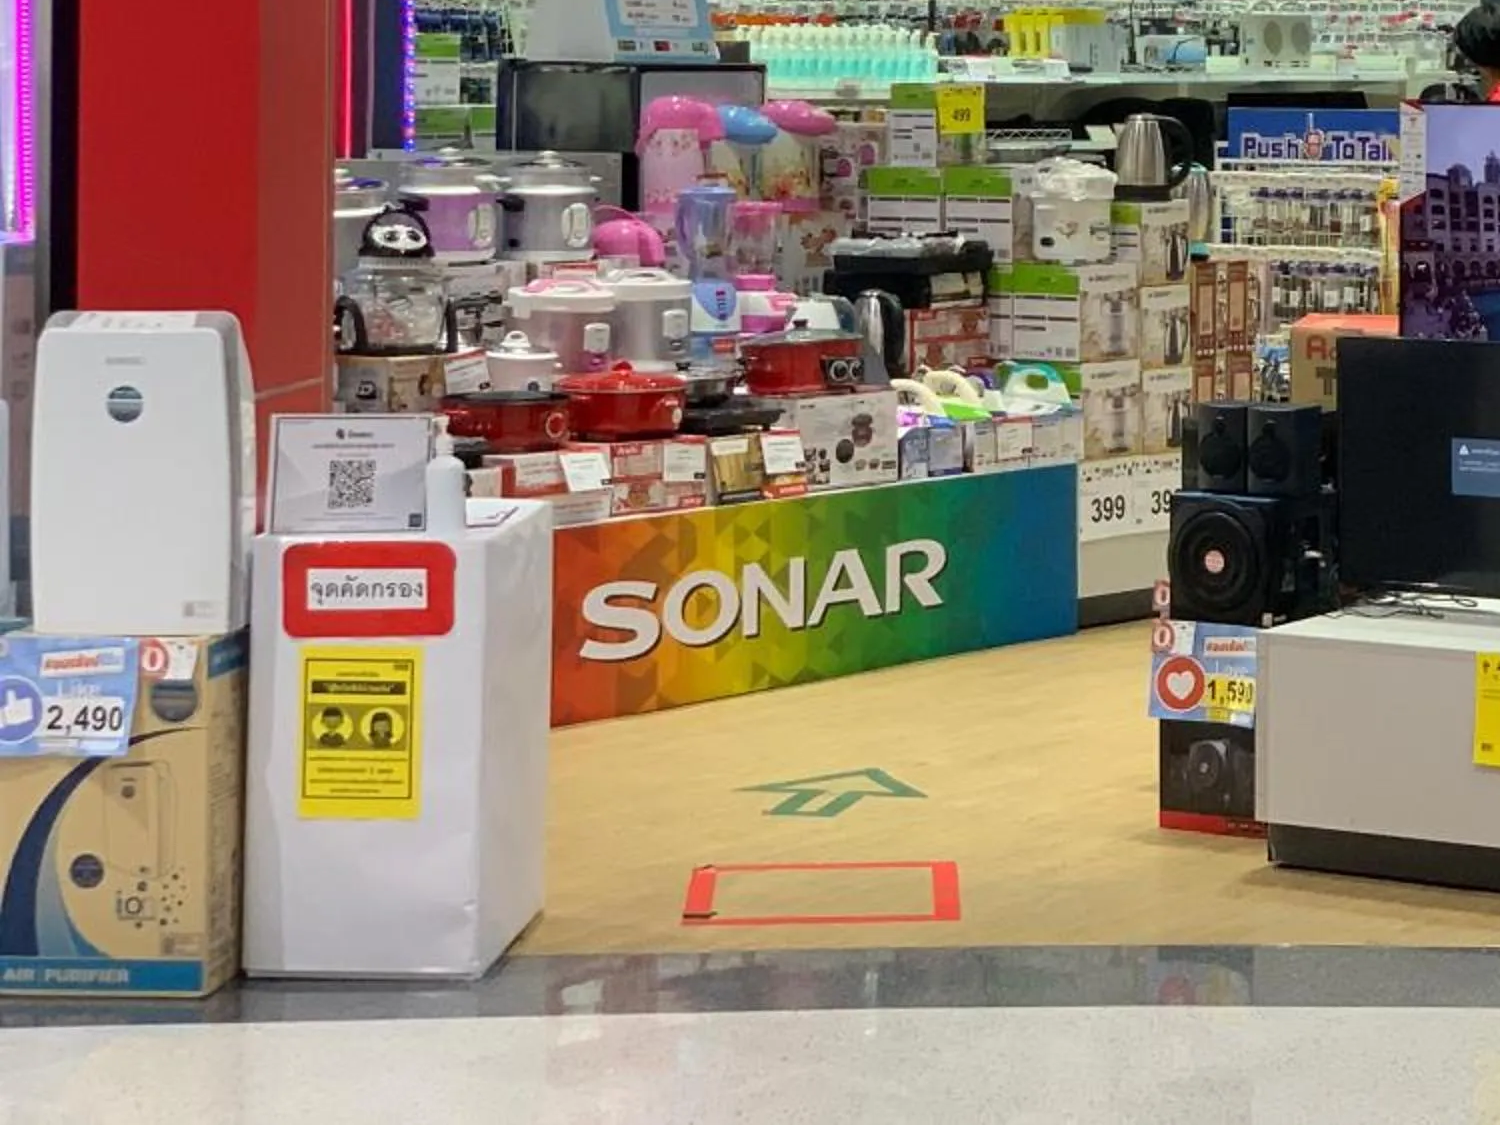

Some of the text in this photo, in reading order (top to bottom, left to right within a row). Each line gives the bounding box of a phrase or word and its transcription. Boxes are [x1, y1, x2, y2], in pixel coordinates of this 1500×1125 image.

[1242, 135, 1300, 159] Push
[1331, 135, 1355, 160] To
[1091, 494, 1126, 524] 399
[311, 575, 424, 605] จุดคัดกรอง
[578, 538, 947, 661] SONAR
[1207, 678, 1254, 705] 1,590
[47, 704, 123, 736] 2,490
